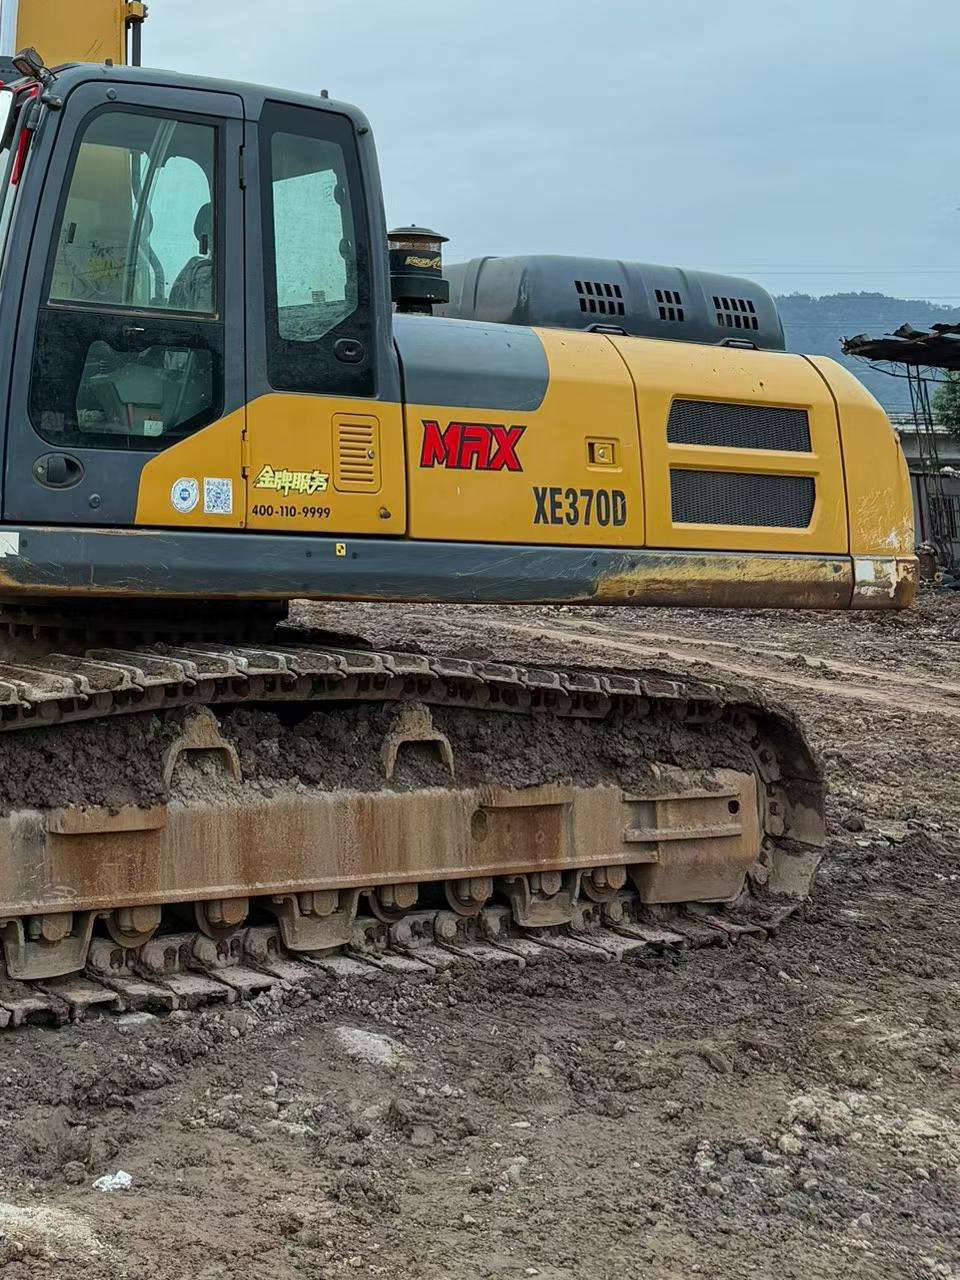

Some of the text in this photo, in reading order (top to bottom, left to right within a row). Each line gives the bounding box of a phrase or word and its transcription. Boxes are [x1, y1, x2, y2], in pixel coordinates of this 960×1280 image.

[419, 419, 528, 473] MAX
[251, 504, 331, 519] 400-110-9999
[532, 486, 627, 527] XE370D
